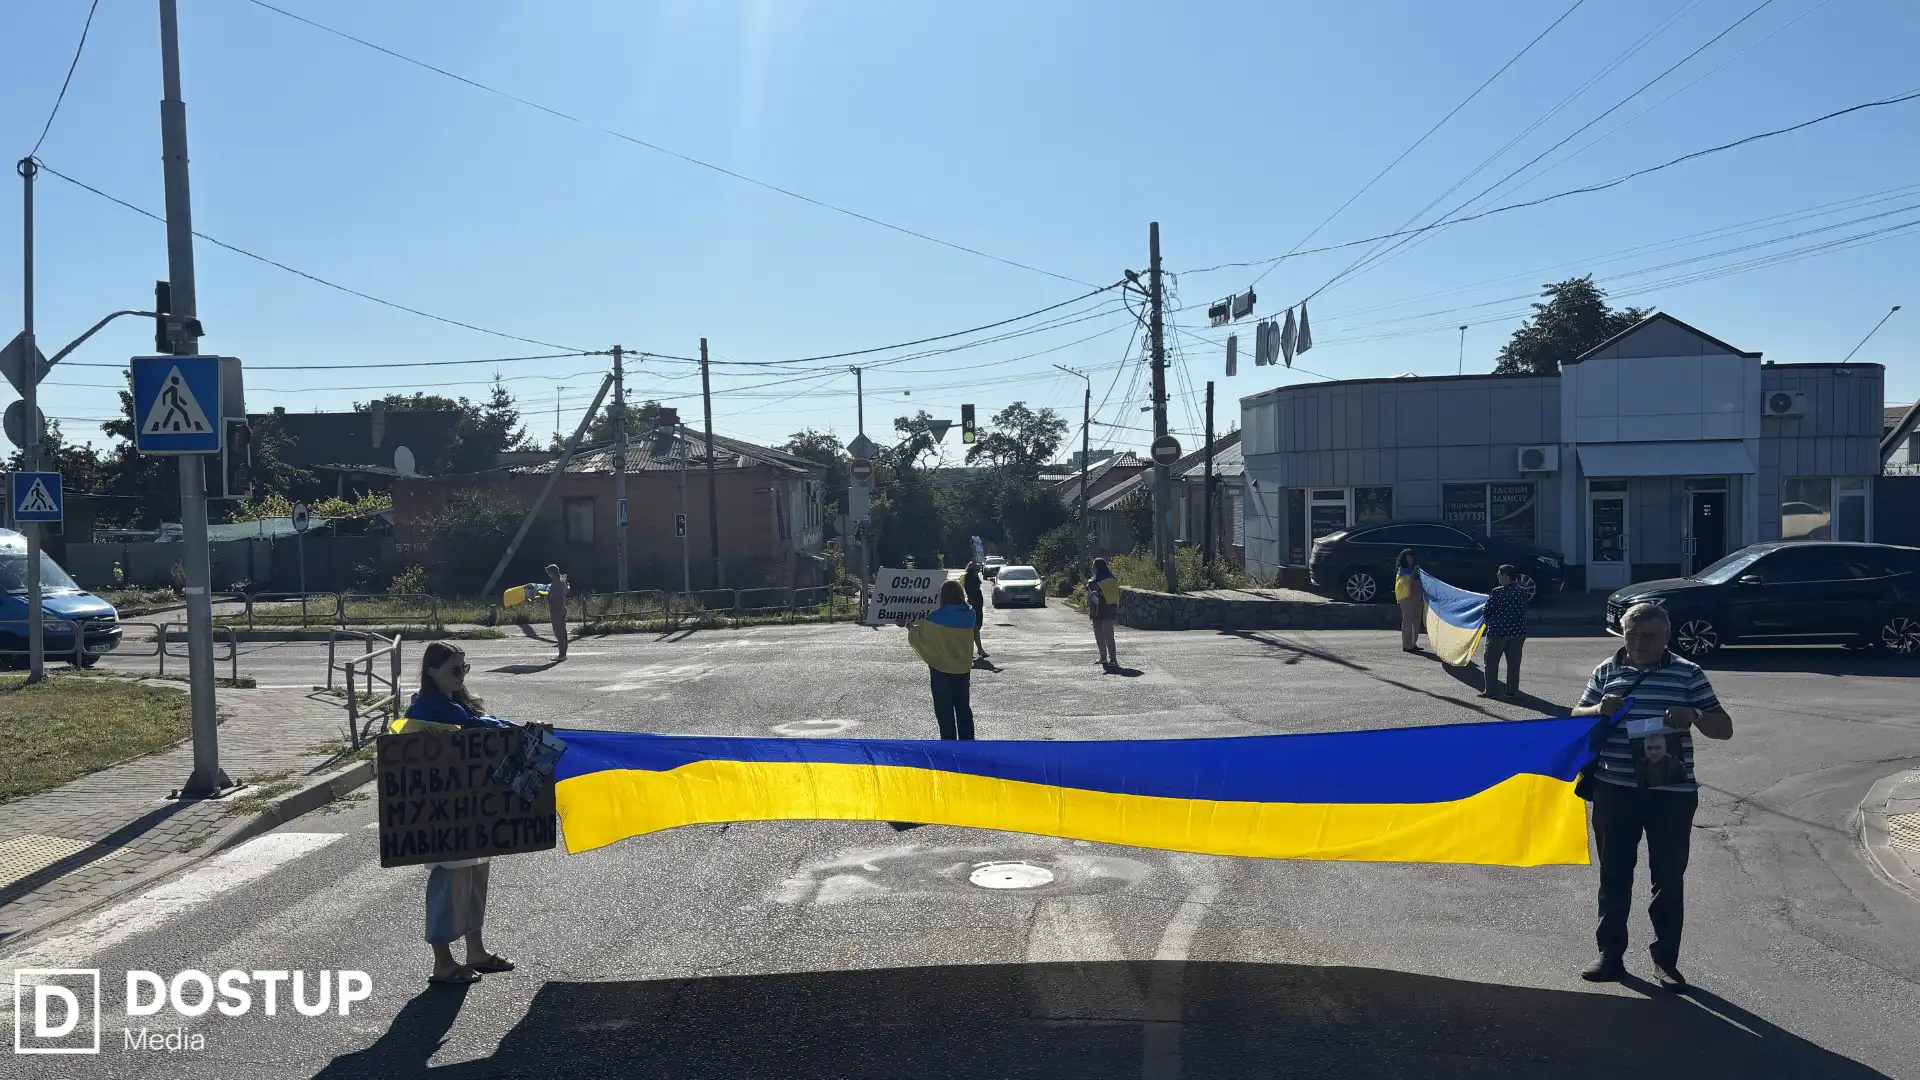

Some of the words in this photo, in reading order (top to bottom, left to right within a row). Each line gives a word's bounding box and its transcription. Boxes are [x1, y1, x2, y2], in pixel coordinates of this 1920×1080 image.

[1491, 494, 1528, 503] ЗАХИСТУ
[891, 576, 931, 589] 09:00
[876, 593, 938, 606] Зупинись!
[878, 608, 930, 622] Вшануй!
[451, 730, 520, 760] ЧЕСТ
[383, 825, 469, 859] НАВІКИ
